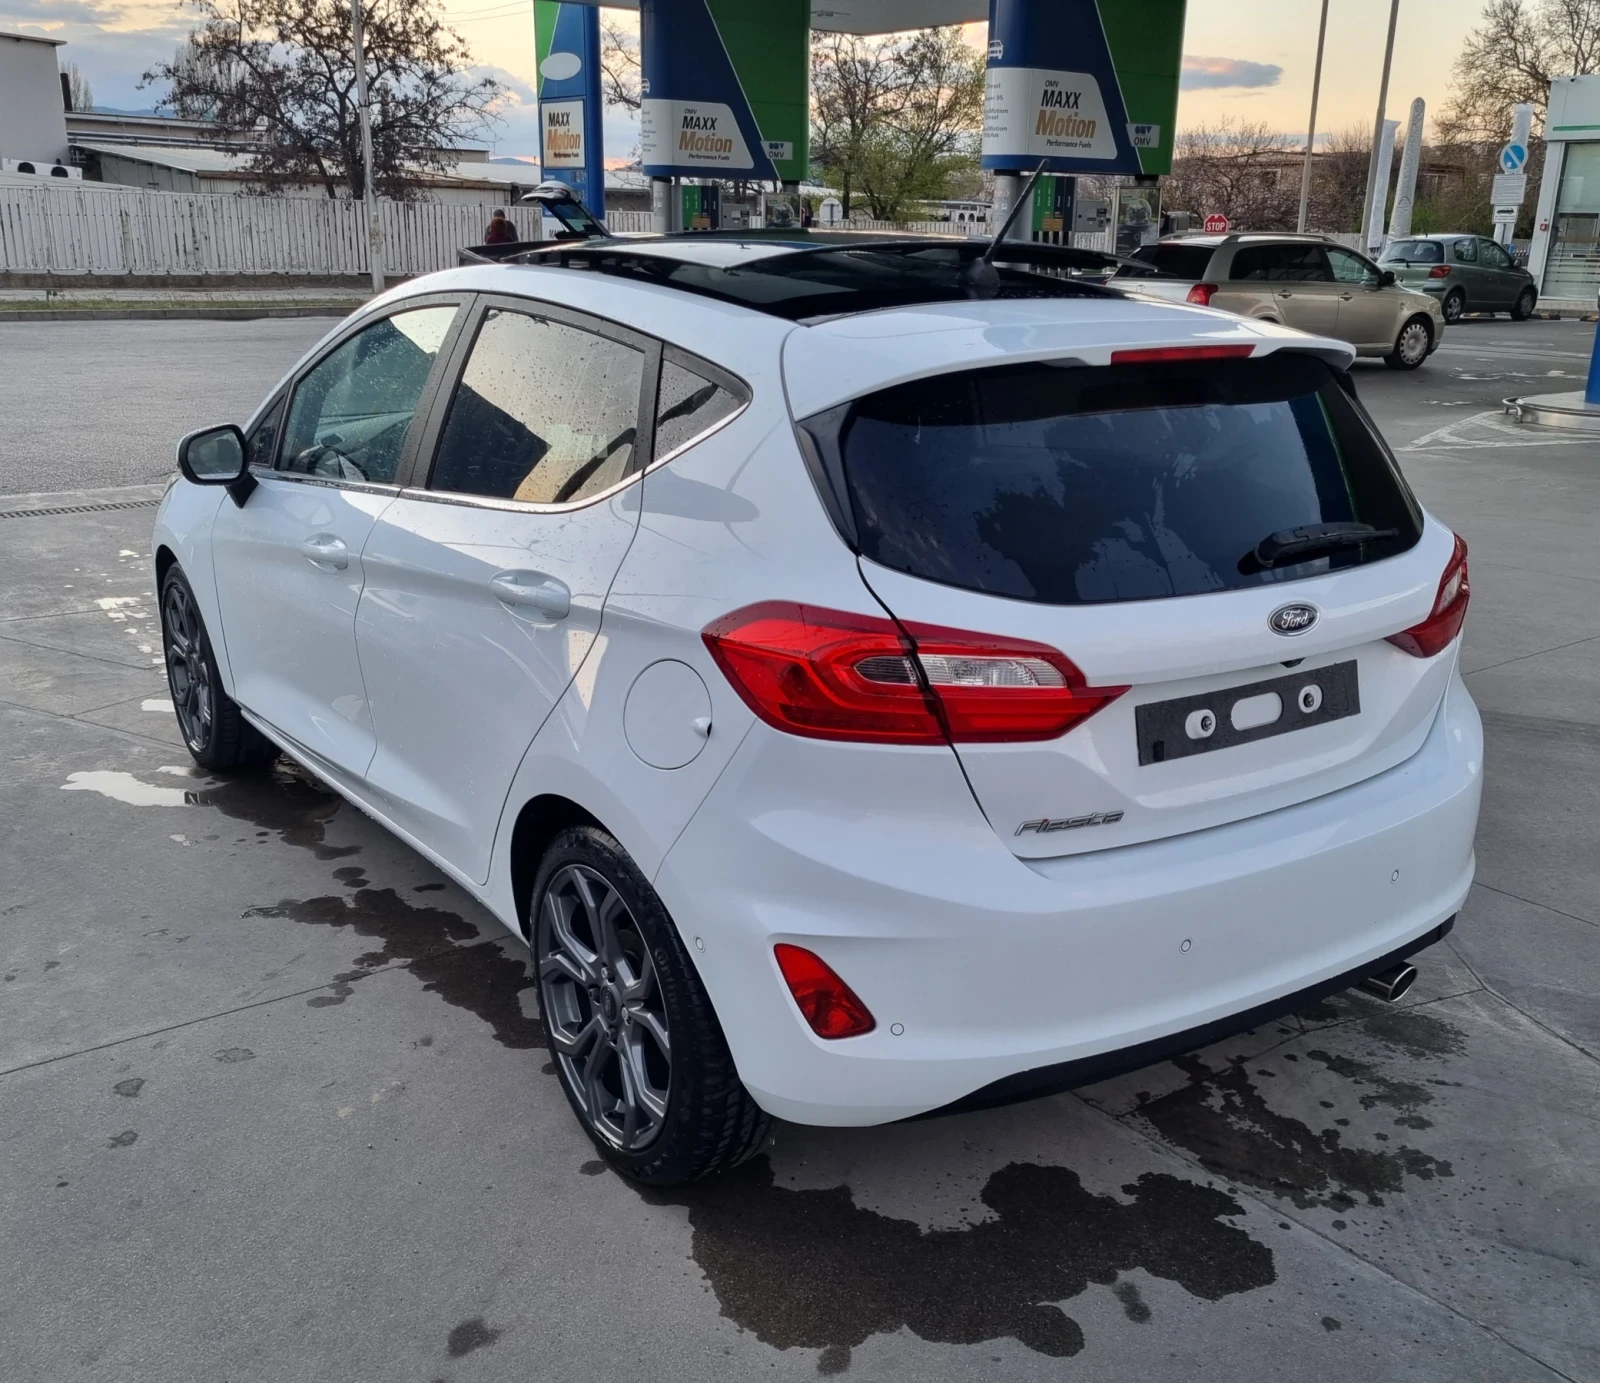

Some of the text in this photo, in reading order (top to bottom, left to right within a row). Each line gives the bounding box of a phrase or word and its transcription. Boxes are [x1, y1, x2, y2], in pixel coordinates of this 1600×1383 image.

[1045, 80, 1059, 88] OMV
[1041, 89, 1081, 109] MAXX
[549, 111, 570, 127] MAXX
[682, 116, 717, 131] MAXX
[1035, 109, 1096, 138] Motion
[547, 128, 581, 151] Motion
[678, 130, 733, 153] Motion
[1046, 139, 1092, 149] Performance Fuels
[1134, 136, 1151, 146] OMV
[1207, 222, 1225, 231] STOP
[1281, 609, 1309, 629] Ford
[1014, 810, 1124, 836] Fiesta
